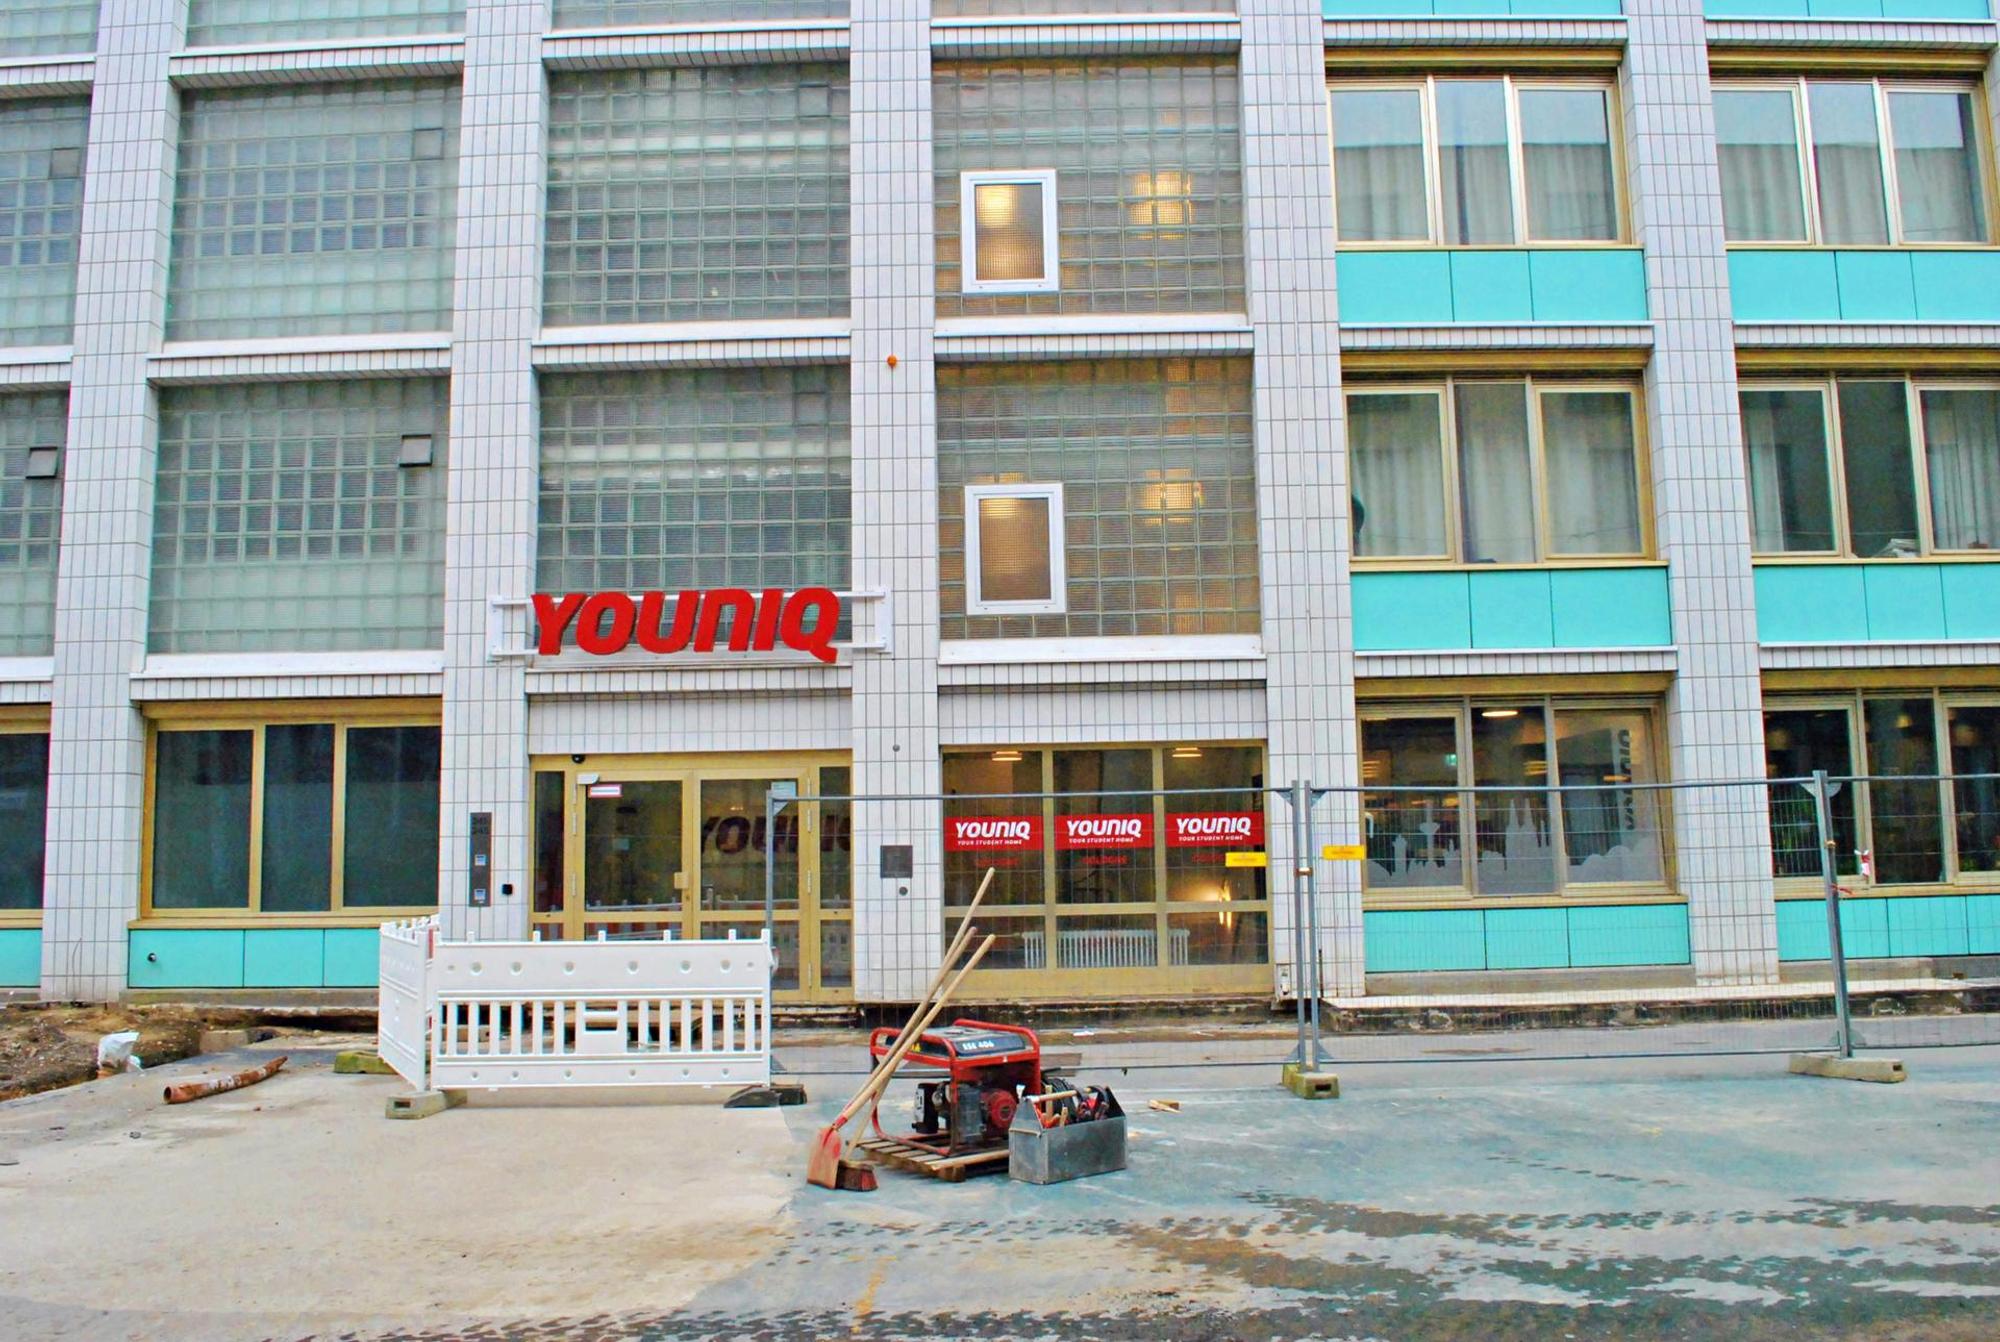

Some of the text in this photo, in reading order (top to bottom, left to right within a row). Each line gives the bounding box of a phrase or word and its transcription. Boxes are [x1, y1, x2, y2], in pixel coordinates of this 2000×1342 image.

[531, 587, 841, 664] YOUNIQ
[956, 821, 1031, 840] YOUNIQ
[1066, 818, 1142, 838] YOUNIQ
[1176, 816, 1252, 836] YOUNIQ
